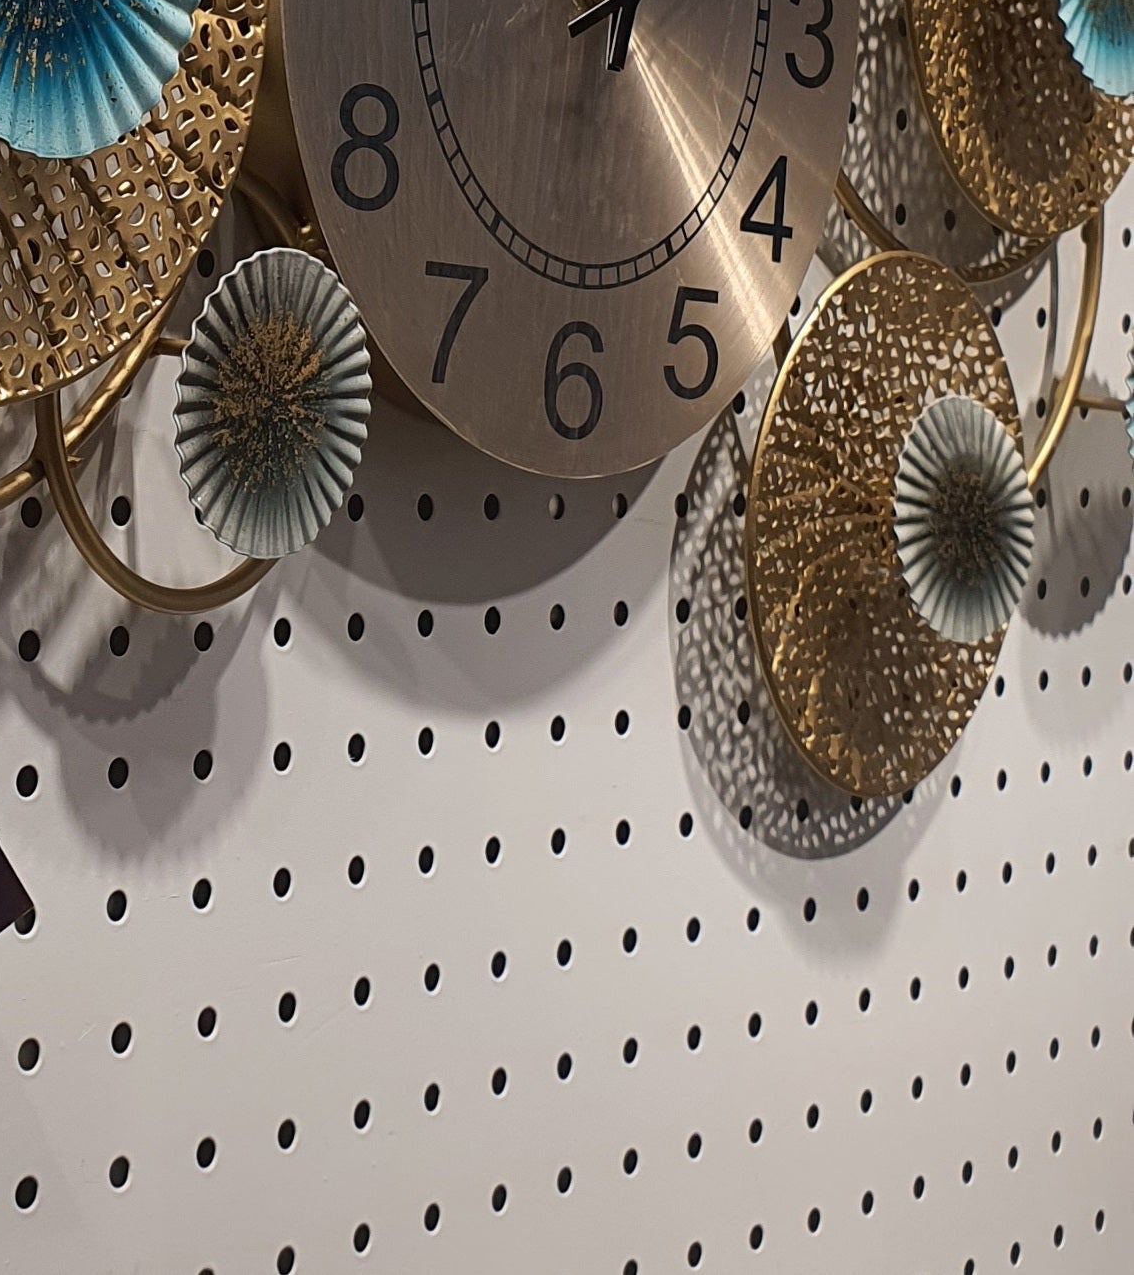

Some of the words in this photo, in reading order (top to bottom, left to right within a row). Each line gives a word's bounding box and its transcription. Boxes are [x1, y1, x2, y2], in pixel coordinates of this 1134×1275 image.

[331, 83, 400, 211] 8
[739, 155, 793, 264] 4
[425, 260, 489, 384] 7
[543, 321, 604, 440] 6
[663, 286, 719, 400] 5
